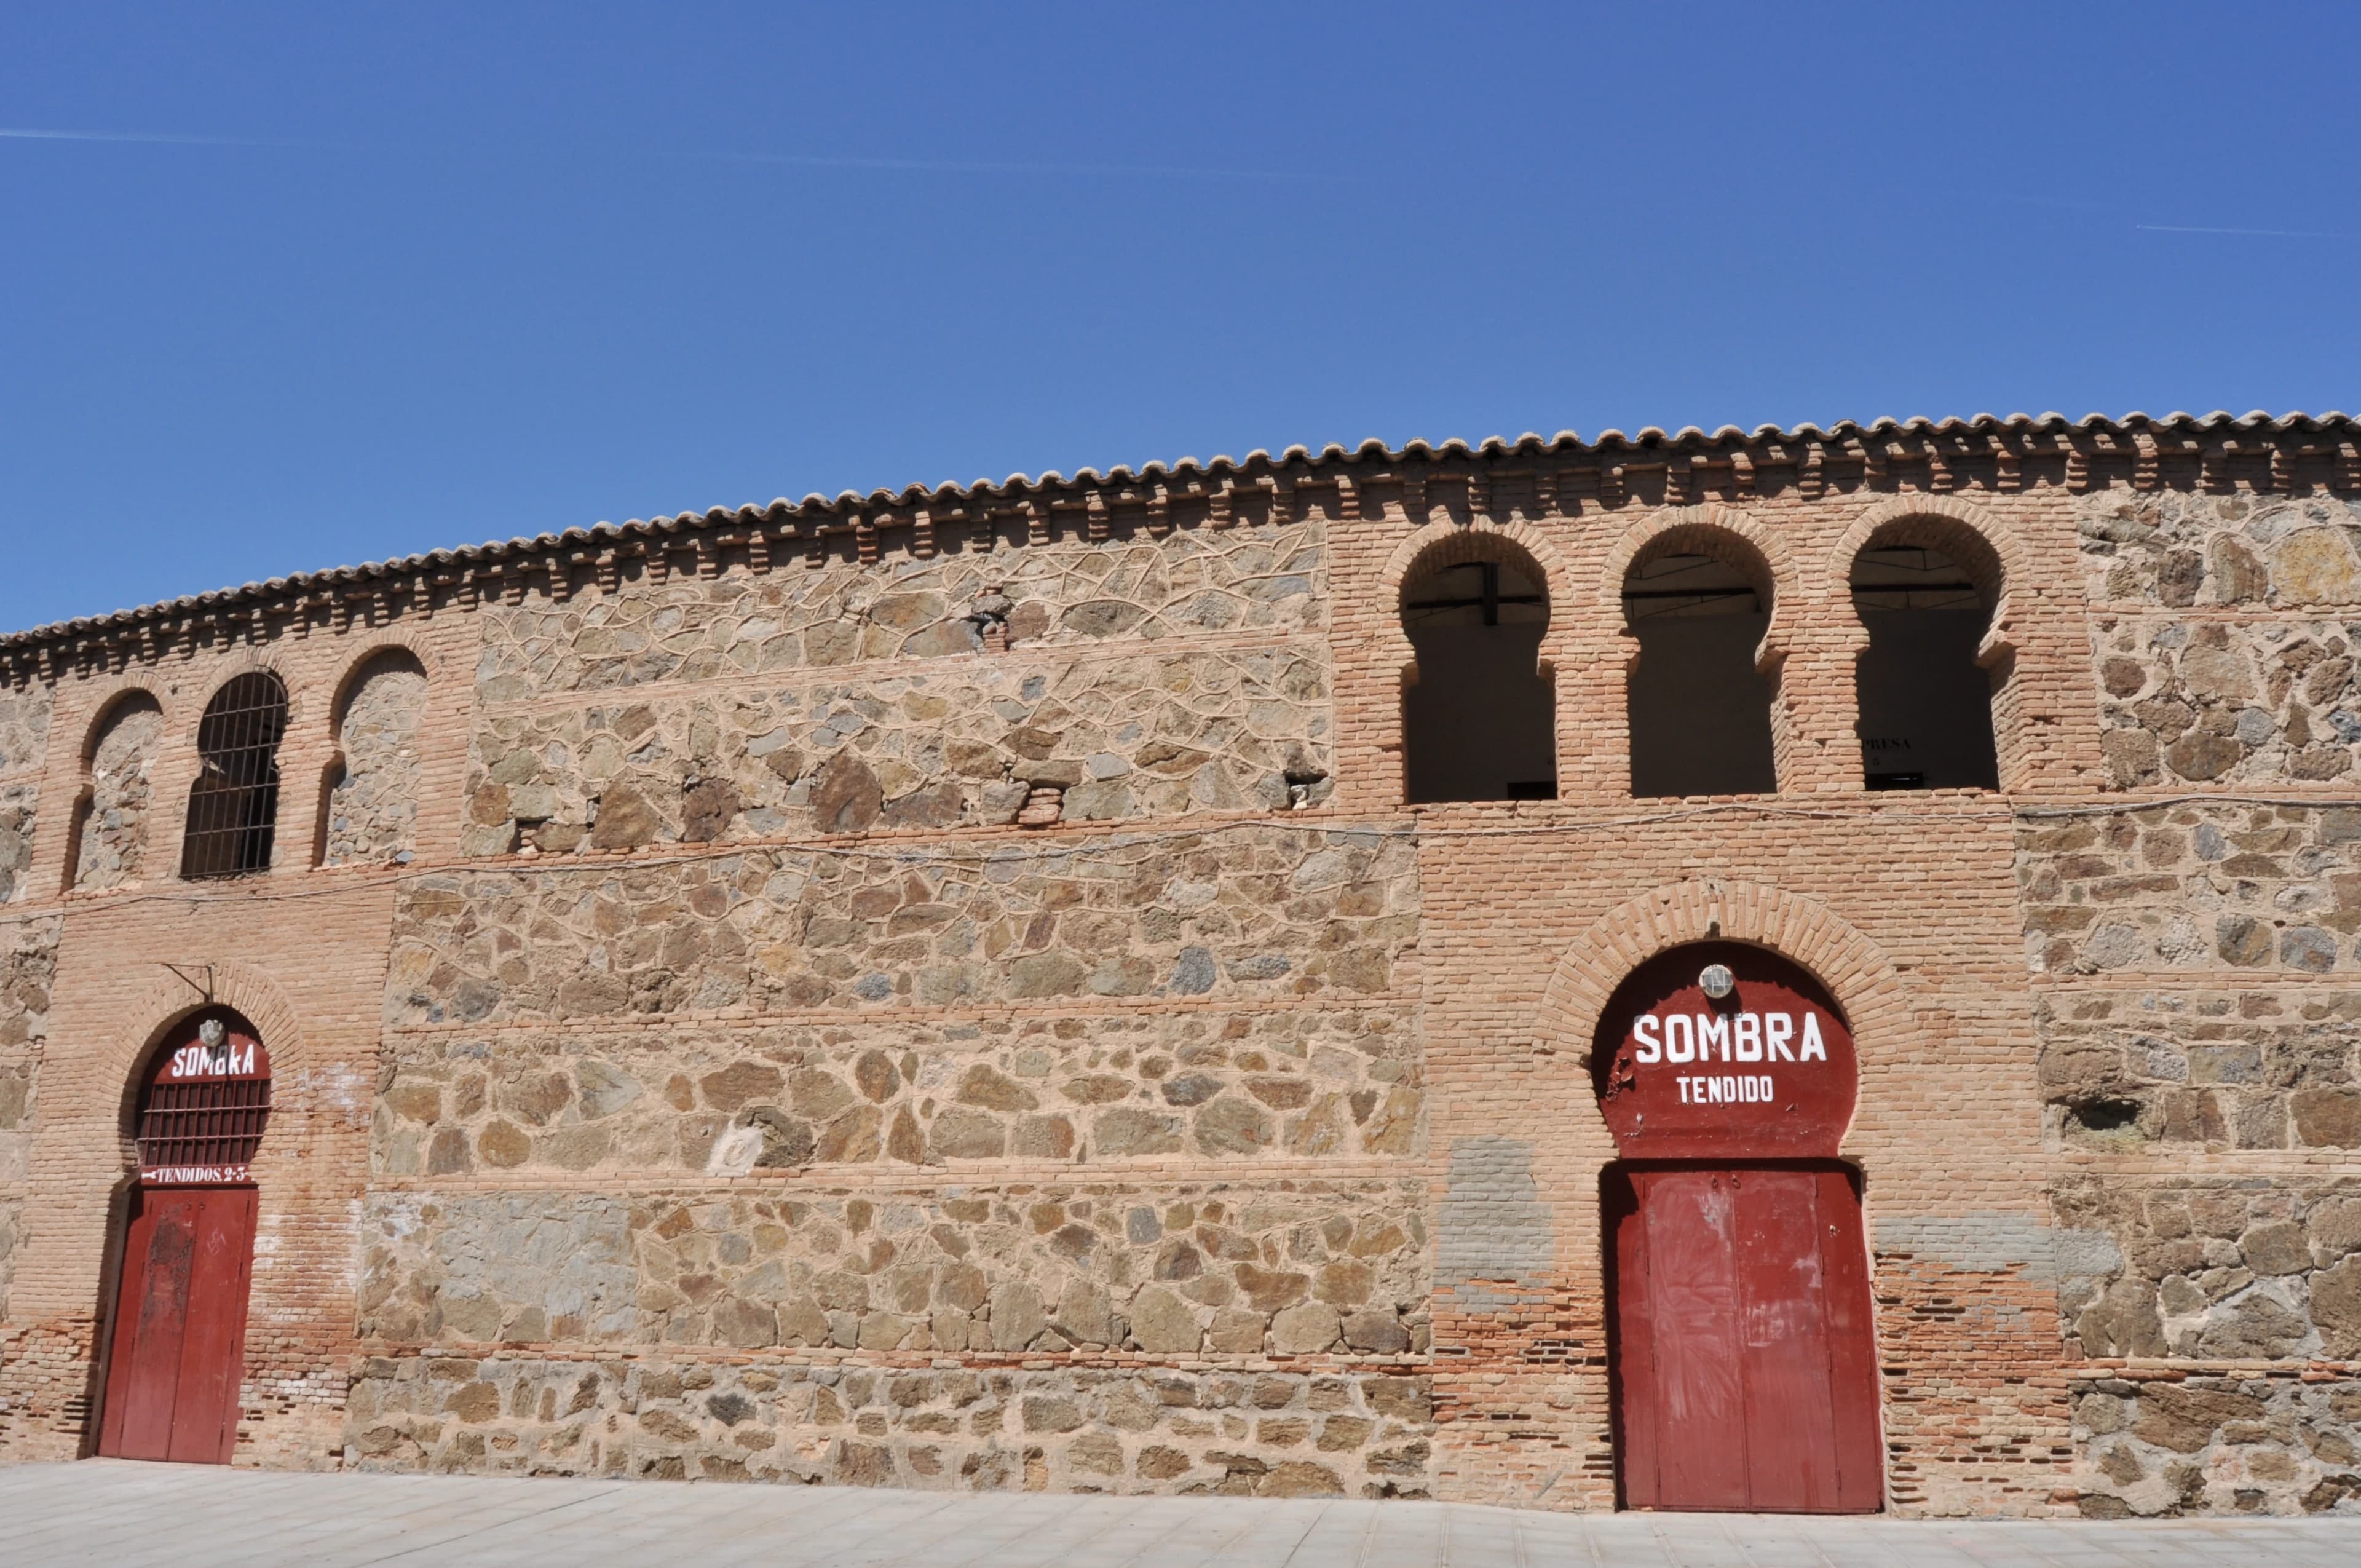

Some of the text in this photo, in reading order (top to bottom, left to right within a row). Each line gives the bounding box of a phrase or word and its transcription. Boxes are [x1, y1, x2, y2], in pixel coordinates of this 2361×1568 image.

[1634, 1012, 1826, 1063] SOMBRA
[172, 1044, 254, 1076] SOMBRA
[1677, 1077, 1773, 1103] TENDIDO
